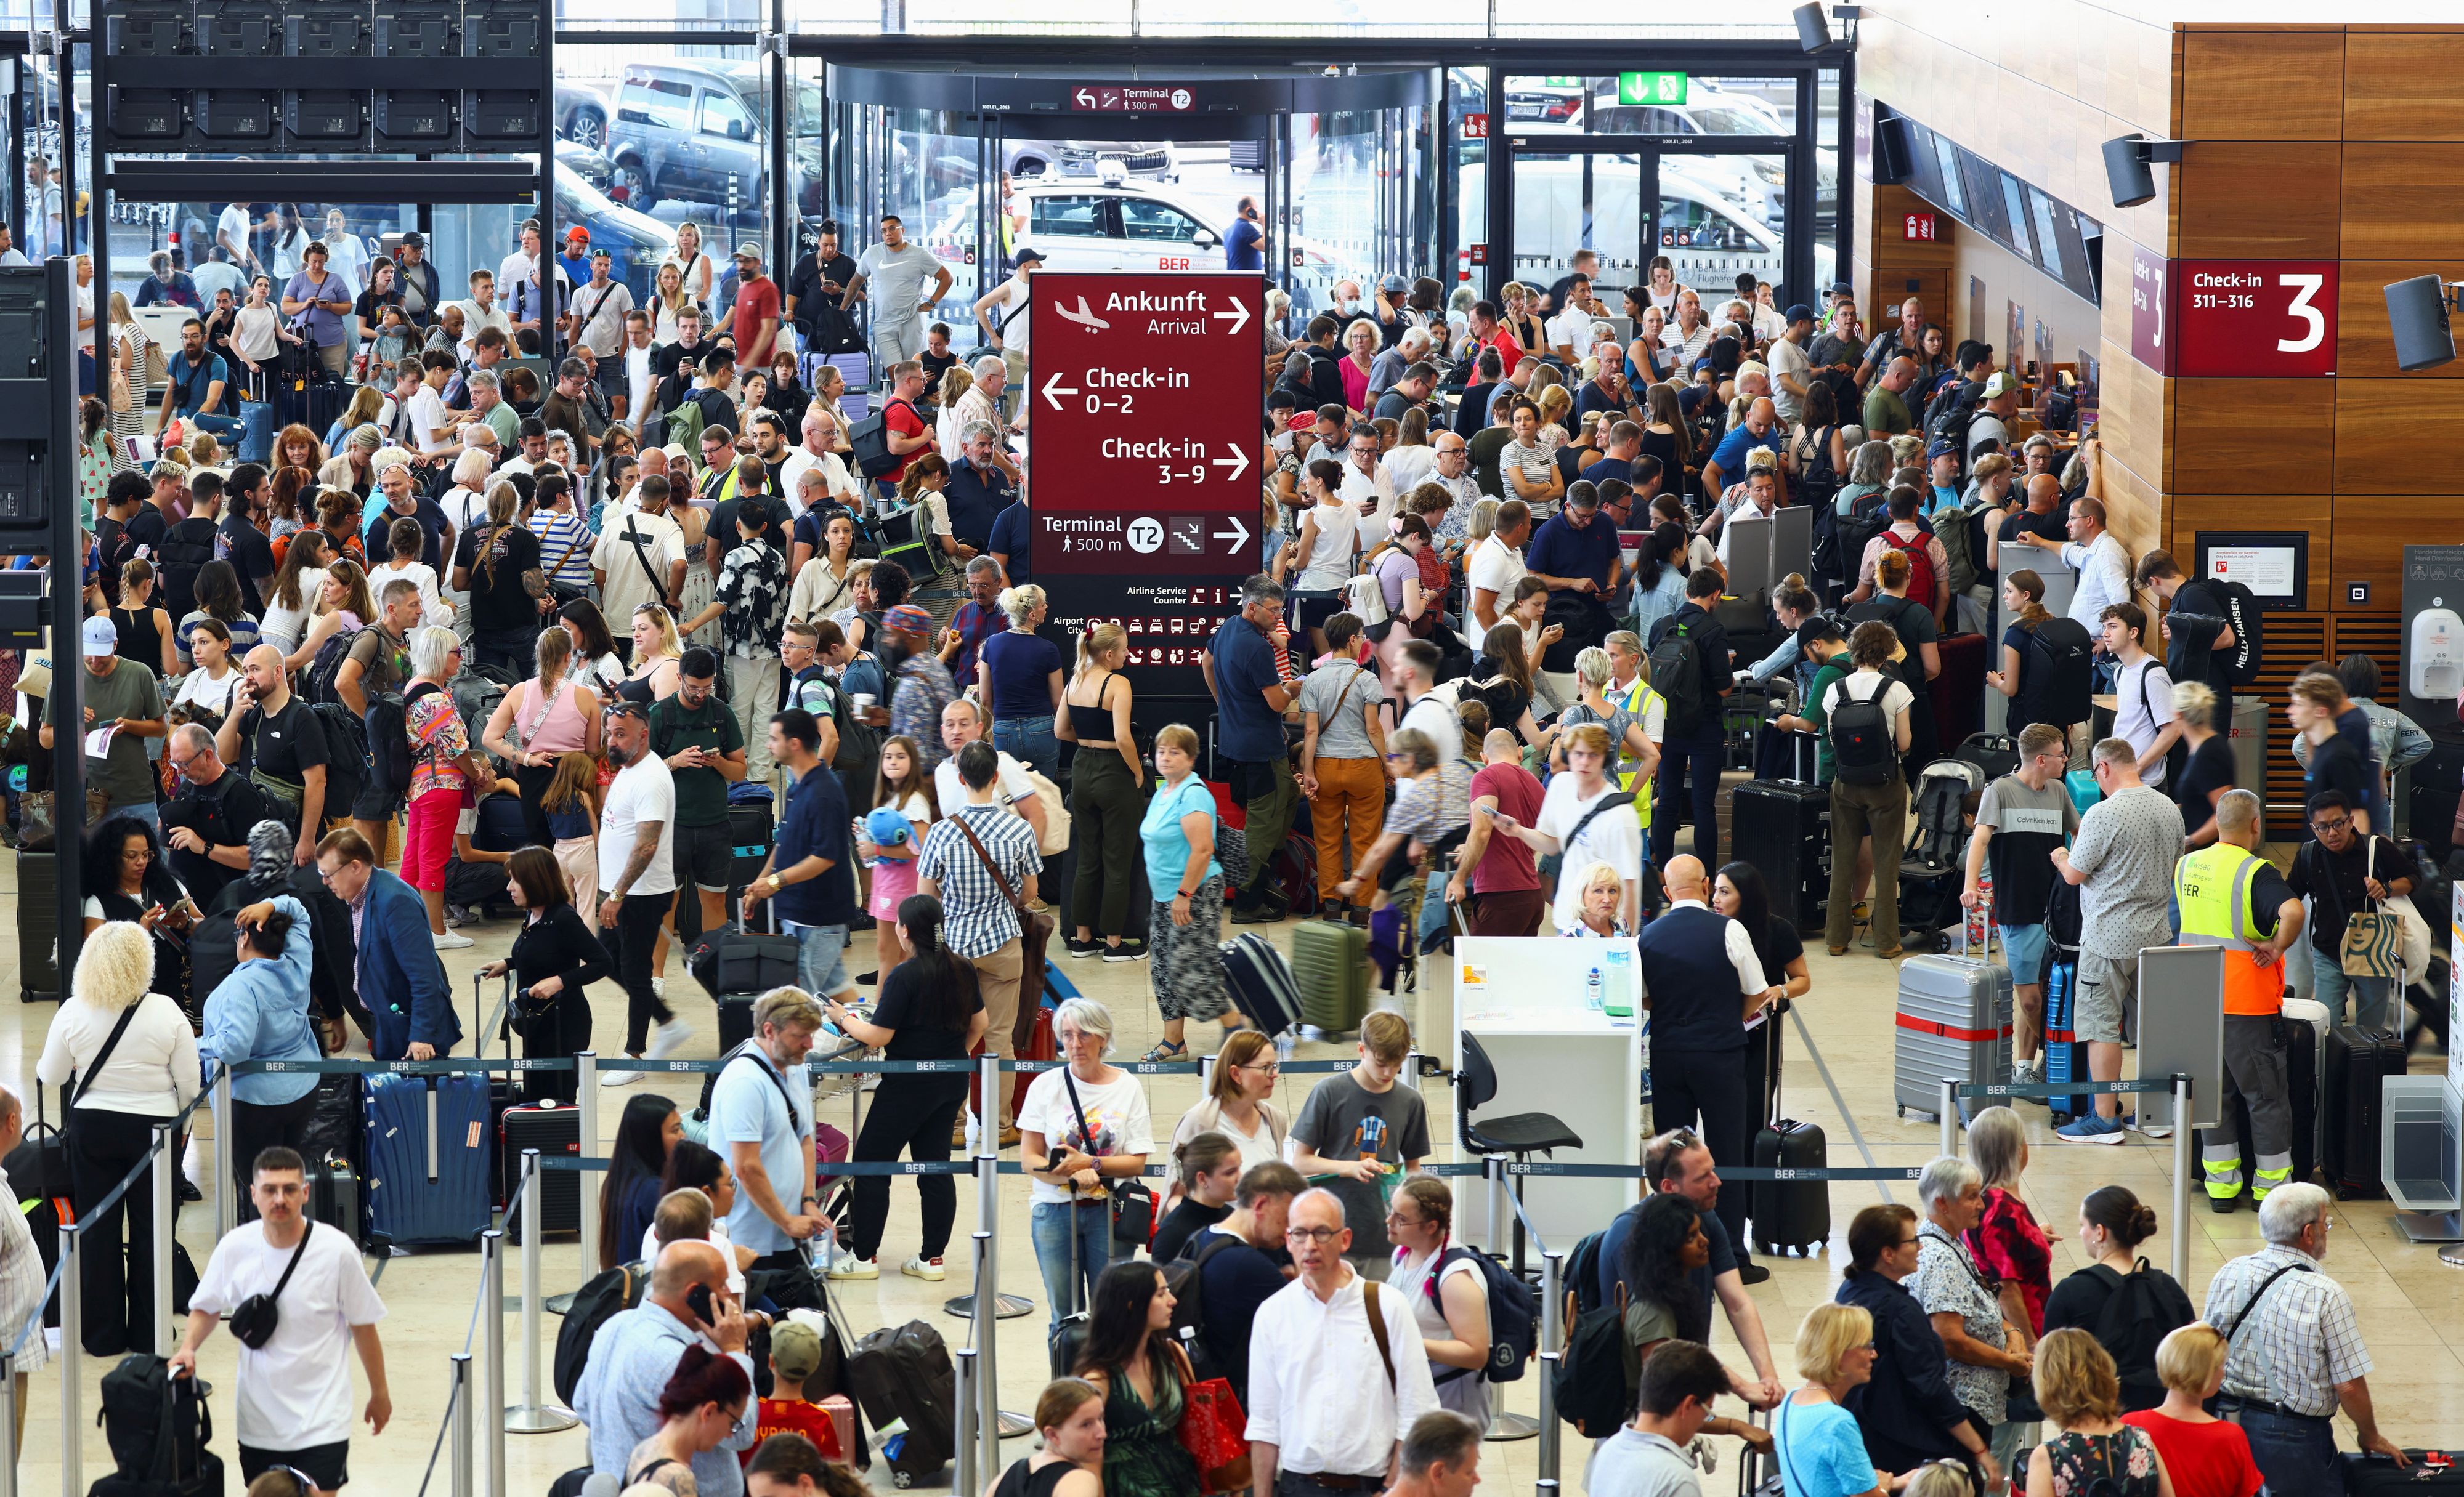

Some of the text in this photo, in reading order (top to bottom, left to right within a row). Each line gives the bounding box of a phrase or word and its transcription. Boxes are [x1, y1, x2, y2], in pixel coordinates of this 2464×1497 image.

[1123, 89, 1188, 104] Terminal T2
[1132, 102, 1147, 110] 300
[1159, 257, 1189, 270] BER
[1698, 264, 1729, 273] Berliner
[1698, 273, 1736, 284] Flughäfen
[1106, 291, 1207, 312] Ankunft
[2134, 256, 2162, 347] Check-in 3
[2193, 294, 2254, 308] 311–316
[2194, 273, 2325, 353] Check-in 3
[1147, 318, 1207, 334] Arrival
[1085, 367, 1189, 388] Check-in
[1102, 437, 1206, 458] Check-in
[1042, 516, 1158, 544] Terminal T2
[1077, 539, 1121, 551] 500 m
[1127, 587, 1154, 595] Airline
[1157, 587, 1186, 595] Service
[1053, 617, 1084, 626] Airport
[2230, 597, 2246, 637] HANSEN
[1068, 626, 1084, 635] City
[2236, 639, 2249, 669] HELLY
[2227, 728, 2239, 738] ER
[266, 1062, 285, 1071] BER
[390, 1062, 409, 1071] BER
[514, 1060, 532, 1069] BER
[670, 1062, 689, 1070] BER
[917, 1062, 935, 1070] BER
[1015, 1062, 1034, 1071] BER
[1138, 1064, 1157, 1073] BER
[1334, 1062, 1352, 1071] BER
[1987, 1086, 2006, 1094] BER
[2110, 1082, 2130, 1091] BER
[1367, 1121, 1379, 1132] 10
[906, 1164, 925, 1172] BER
[1154, 1166, 1166, 1176] BE
[1510, 1164, 1531, 1173] BER
[1775, 1170, 1795, 1179] BER
[1907, 1169, 1921, 1178] BE
